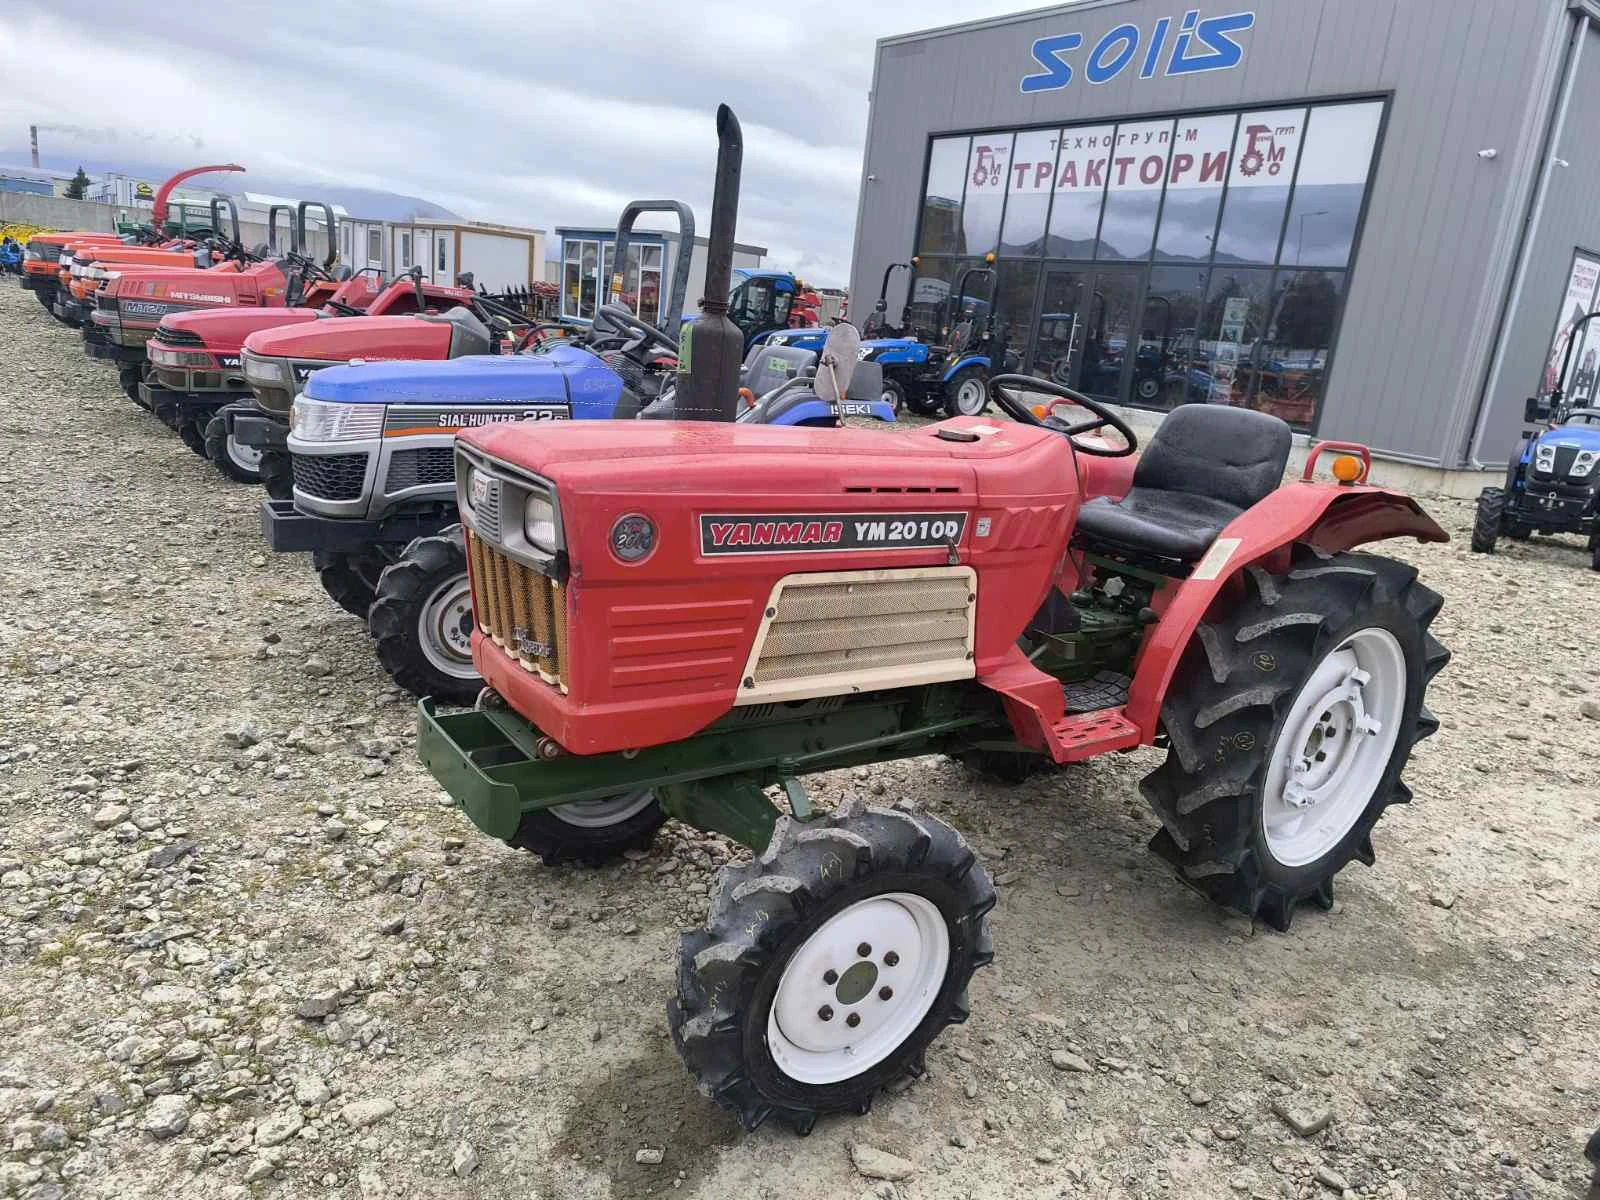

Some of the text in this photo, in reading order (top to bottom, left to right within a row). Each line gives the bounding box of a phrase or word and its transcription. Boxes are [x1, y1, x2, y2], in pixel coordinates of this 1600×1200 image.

[1050, 129, 1198, 151] ТЕХНОГРУП-М
[1014, 151, 1228, 188] ТРАКТОРИ
[831, 404, 872, 415] ISEKI
[710, 521, 843, 546] YANMAR
